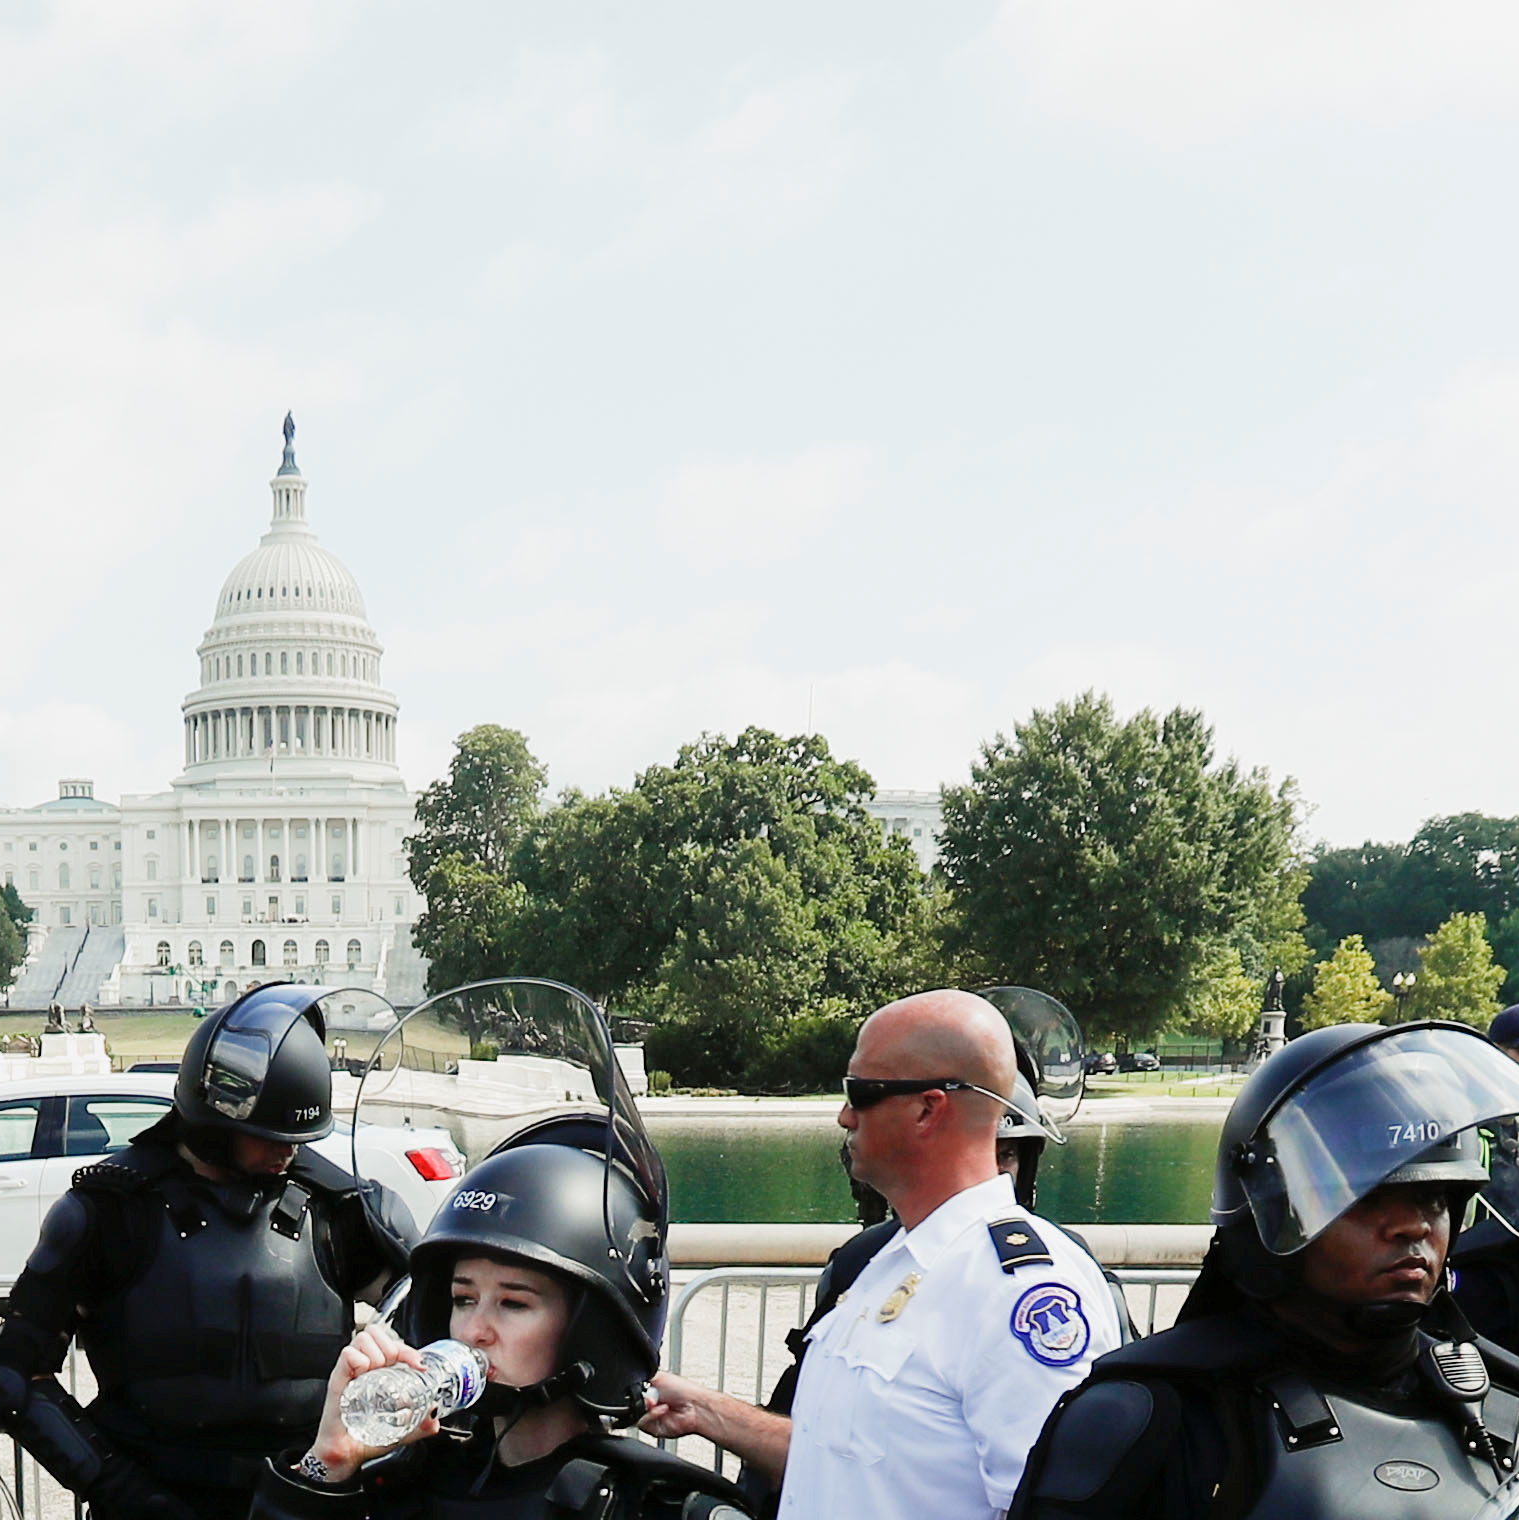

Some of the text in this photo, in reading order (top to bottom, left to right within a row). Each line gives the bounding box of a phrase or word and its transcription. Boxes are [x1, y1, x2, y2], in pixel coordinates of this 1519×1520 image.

[295, 1105, 320, 1122] 7194
[1388, 1122, 1440, 1145] 7410
[453, 1190, 497, 1211] 6929
